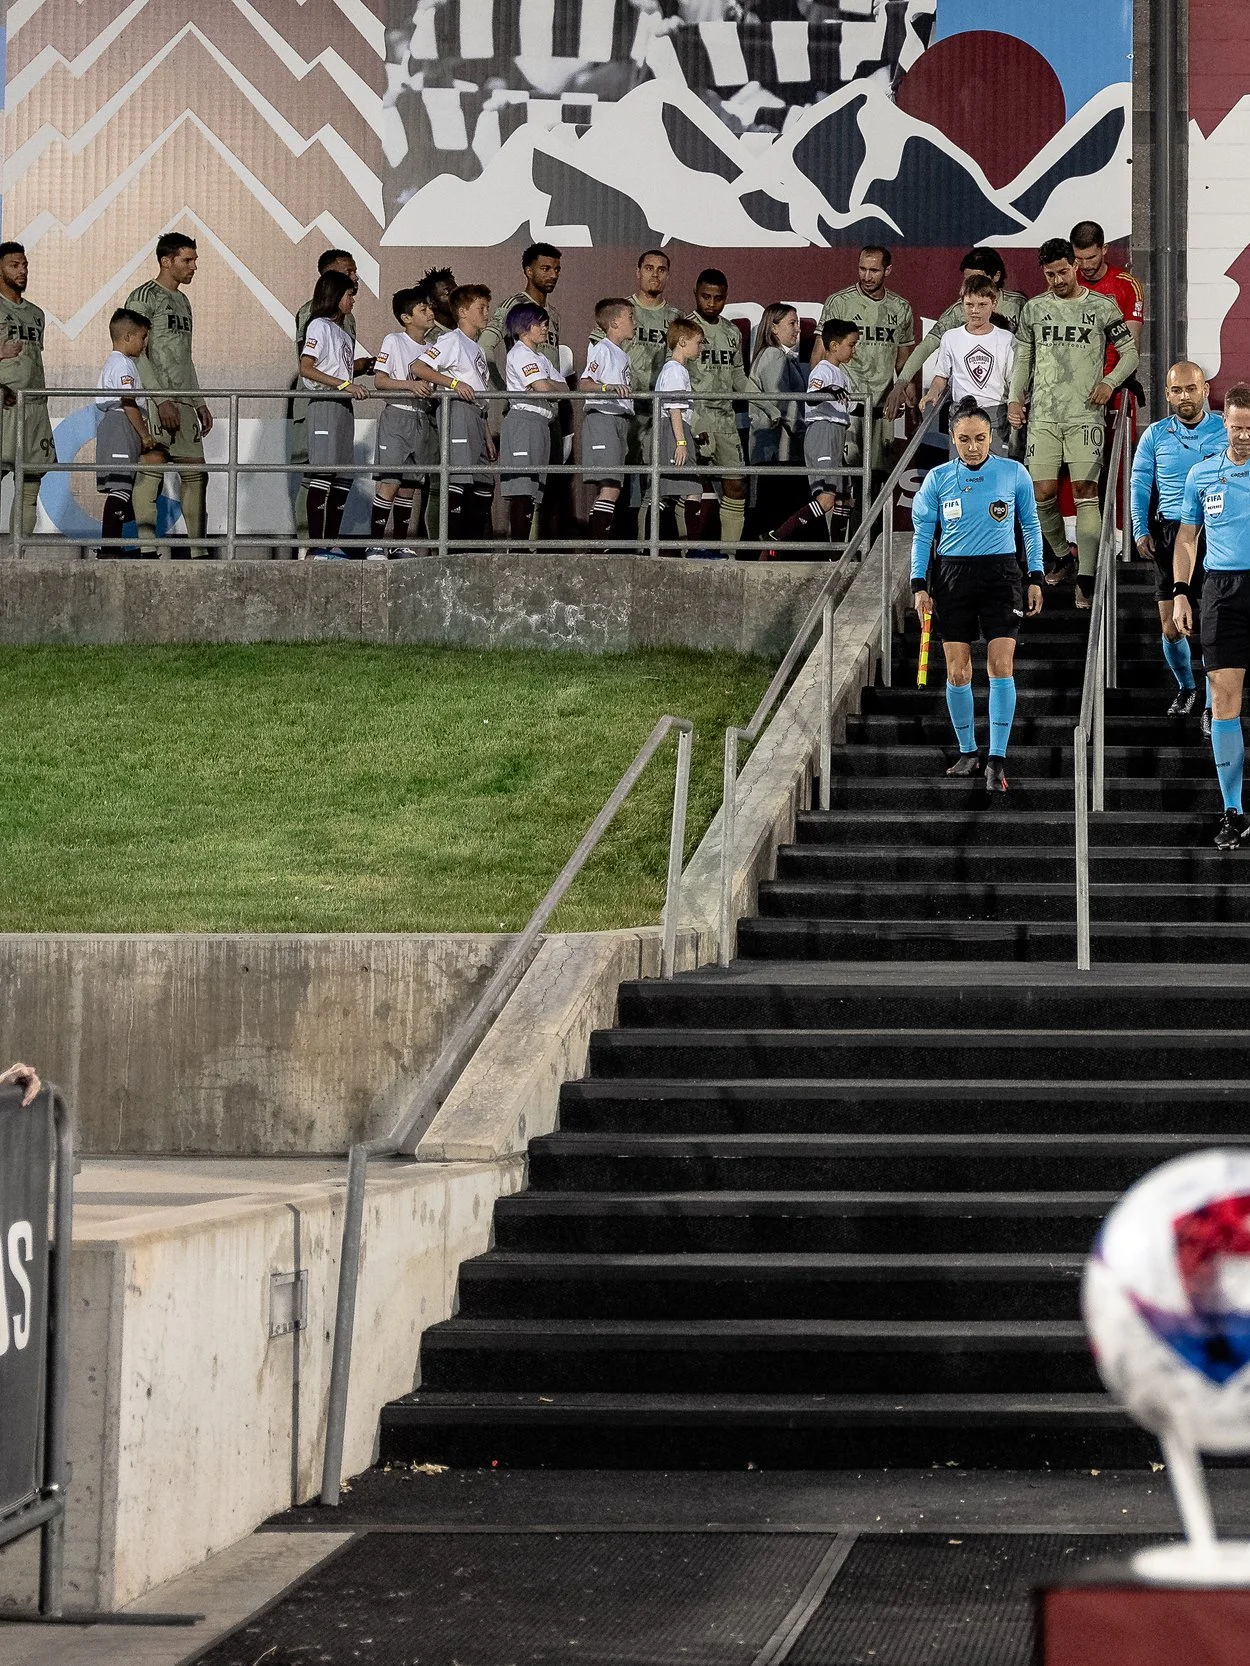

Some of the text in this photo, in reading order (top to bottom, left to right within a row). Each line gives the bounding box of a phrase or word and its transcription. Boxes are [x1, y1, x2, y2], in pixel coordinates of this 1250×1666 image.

[167, 315, 192, 331] FLE
[638, 327, 667, 344] LEX
[1042, 326, 1092, 345] FLEX
[1081, 425, 1104, 447] 10
[944, 500, 960, 509] FIFA
[1206, 494, 1222, 503] FIFA
